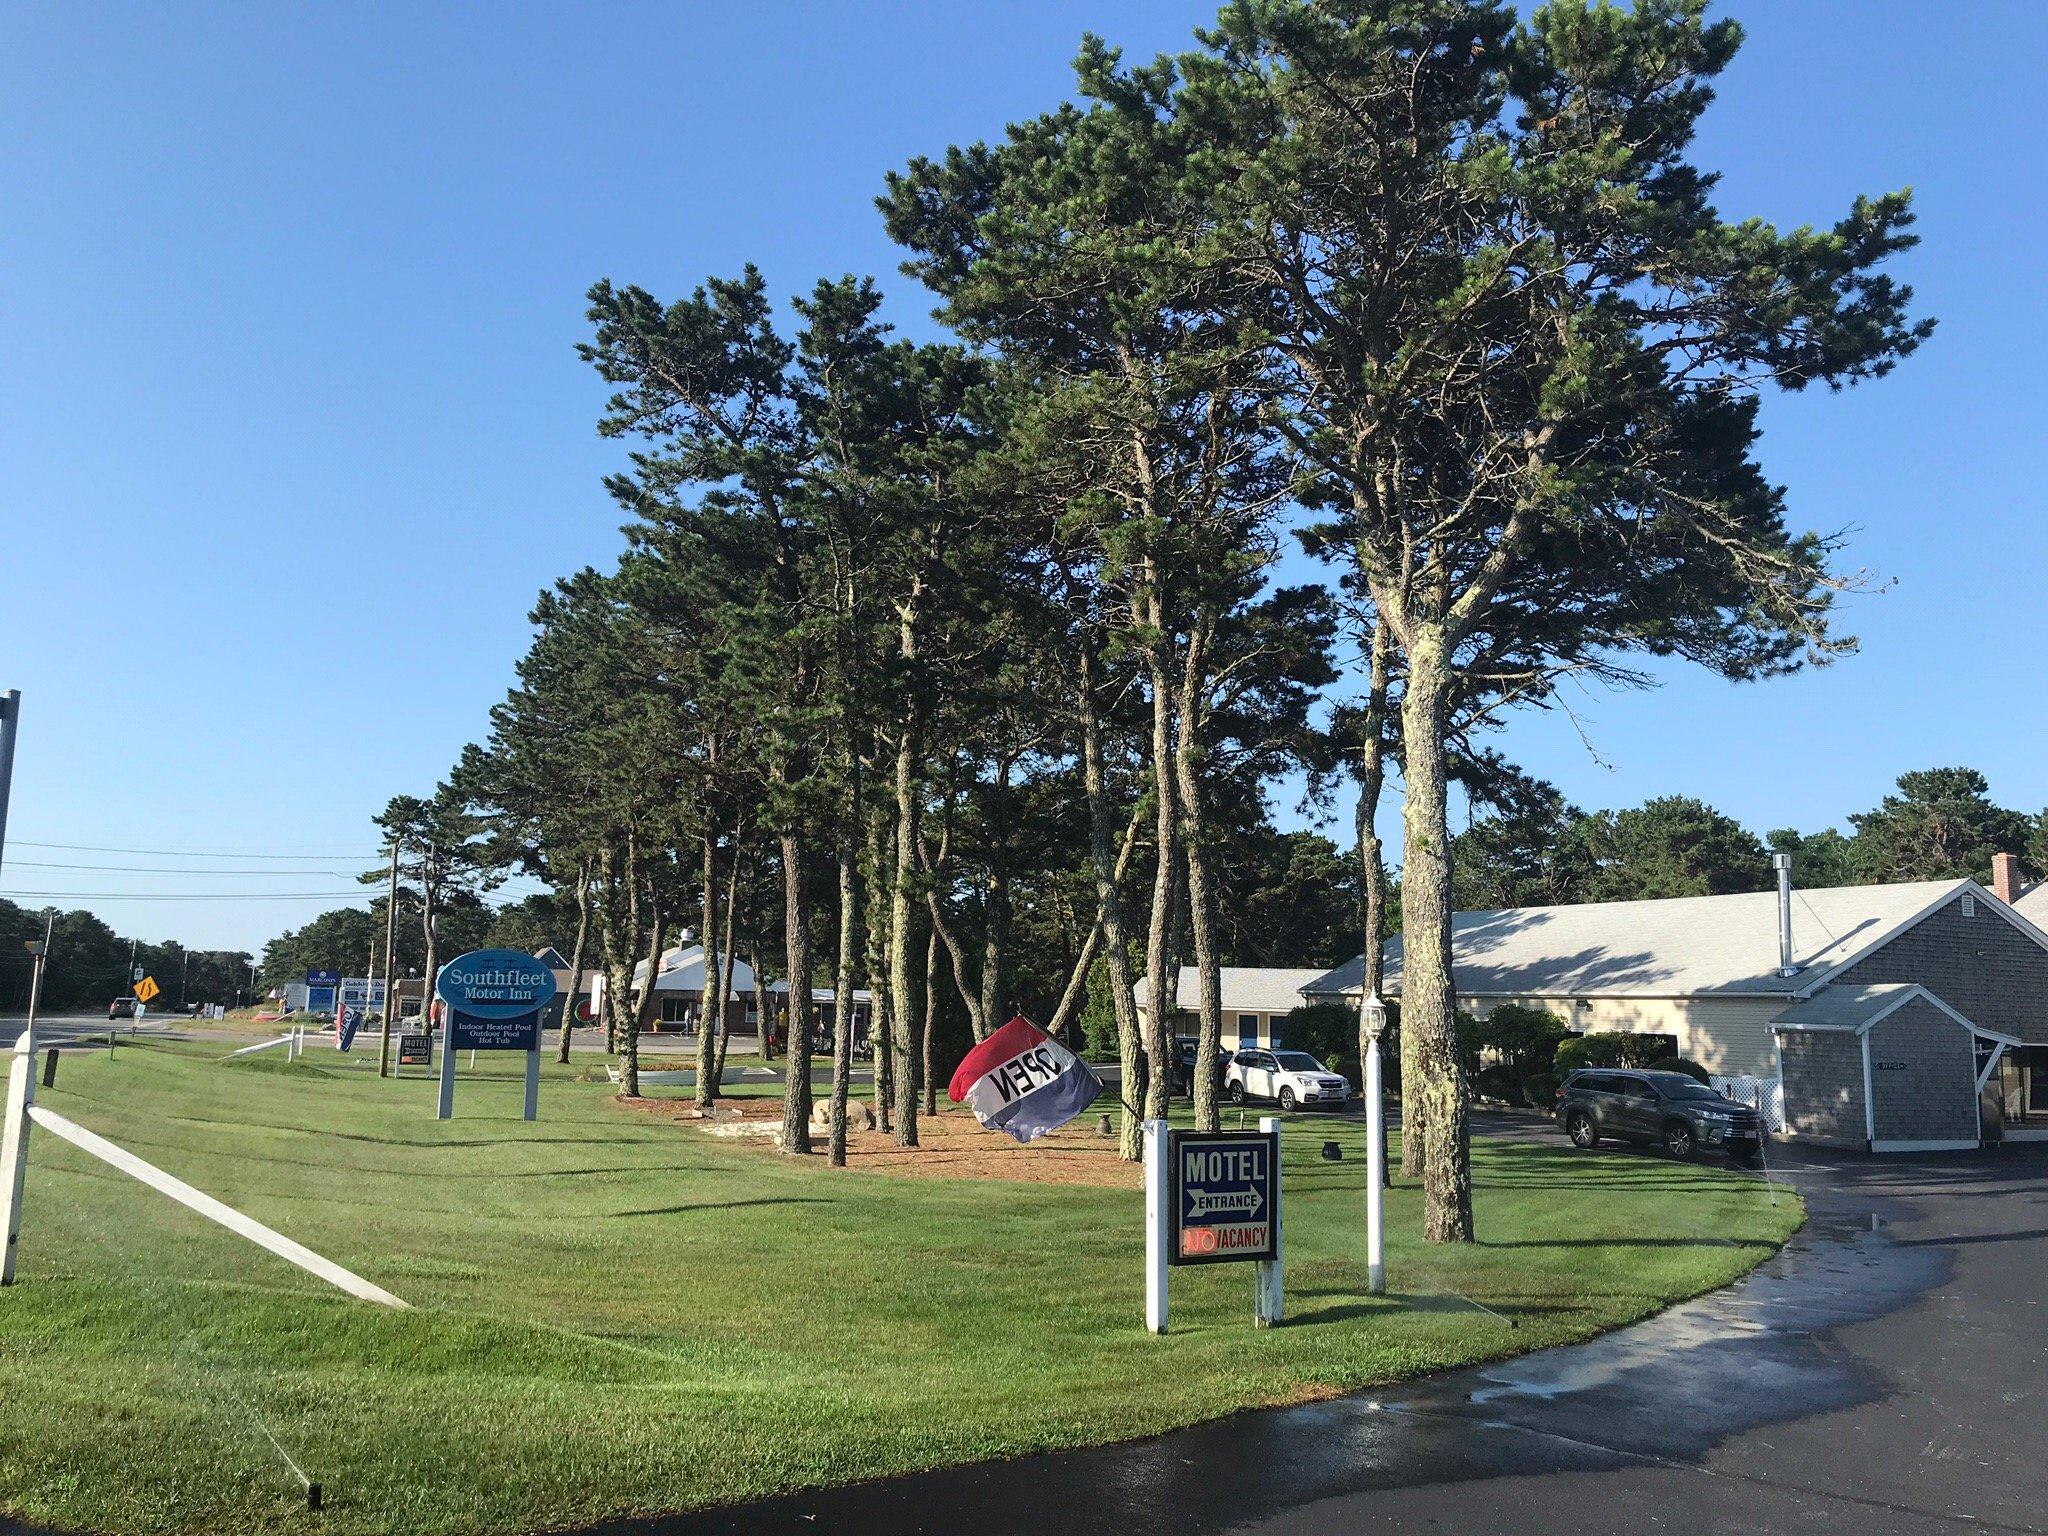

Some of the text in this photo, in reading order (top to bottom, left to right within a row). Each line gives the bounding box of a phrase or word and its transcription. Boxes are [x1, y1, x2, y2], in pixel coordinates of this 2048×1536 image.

[450, 969, 547, 986] Southfleet
[464, 987, 532, 1000] Motor Inn
[487, 1023, 512, 1031] Heated
[1186, 1151, 1265, 1183] MOTEL
[1198, 1194, 1257, 1209] ENTRANCE
